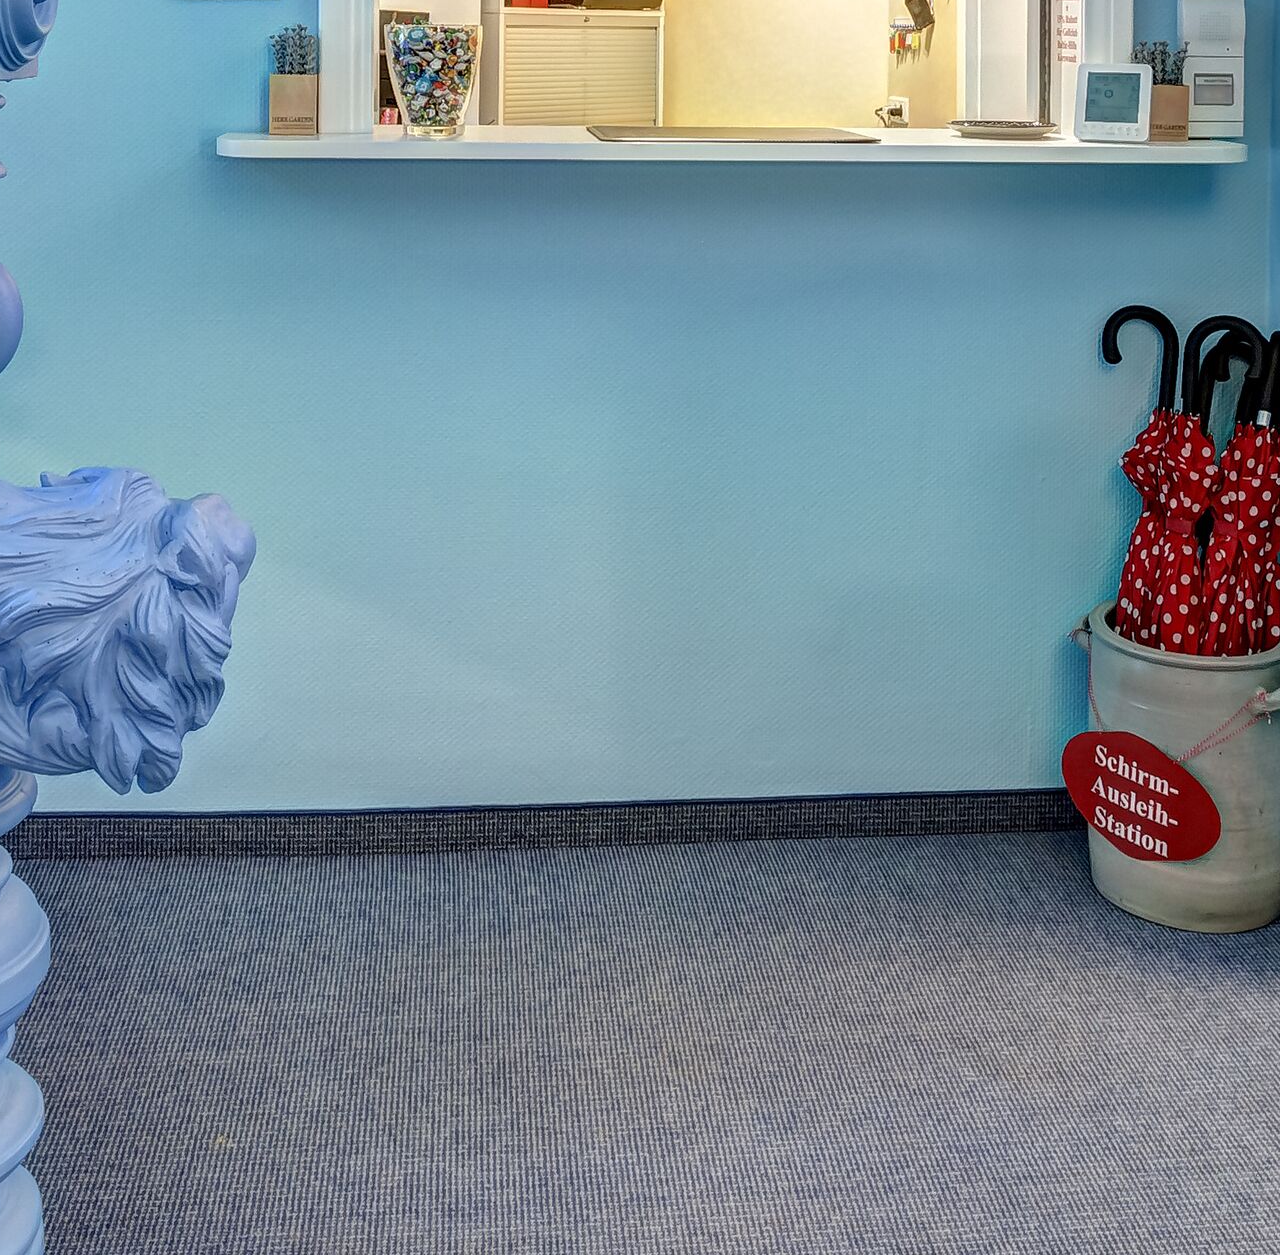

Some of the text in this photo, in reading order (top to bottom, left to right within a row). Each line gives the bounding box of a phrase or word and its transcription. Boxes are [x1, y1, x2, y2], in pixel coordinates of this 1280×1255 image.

[1095, 744, 1179, 796] Schirm-
[1091, 775, 1179, 828] Ausleih-
[1093, 805, 1169, 859] Station
